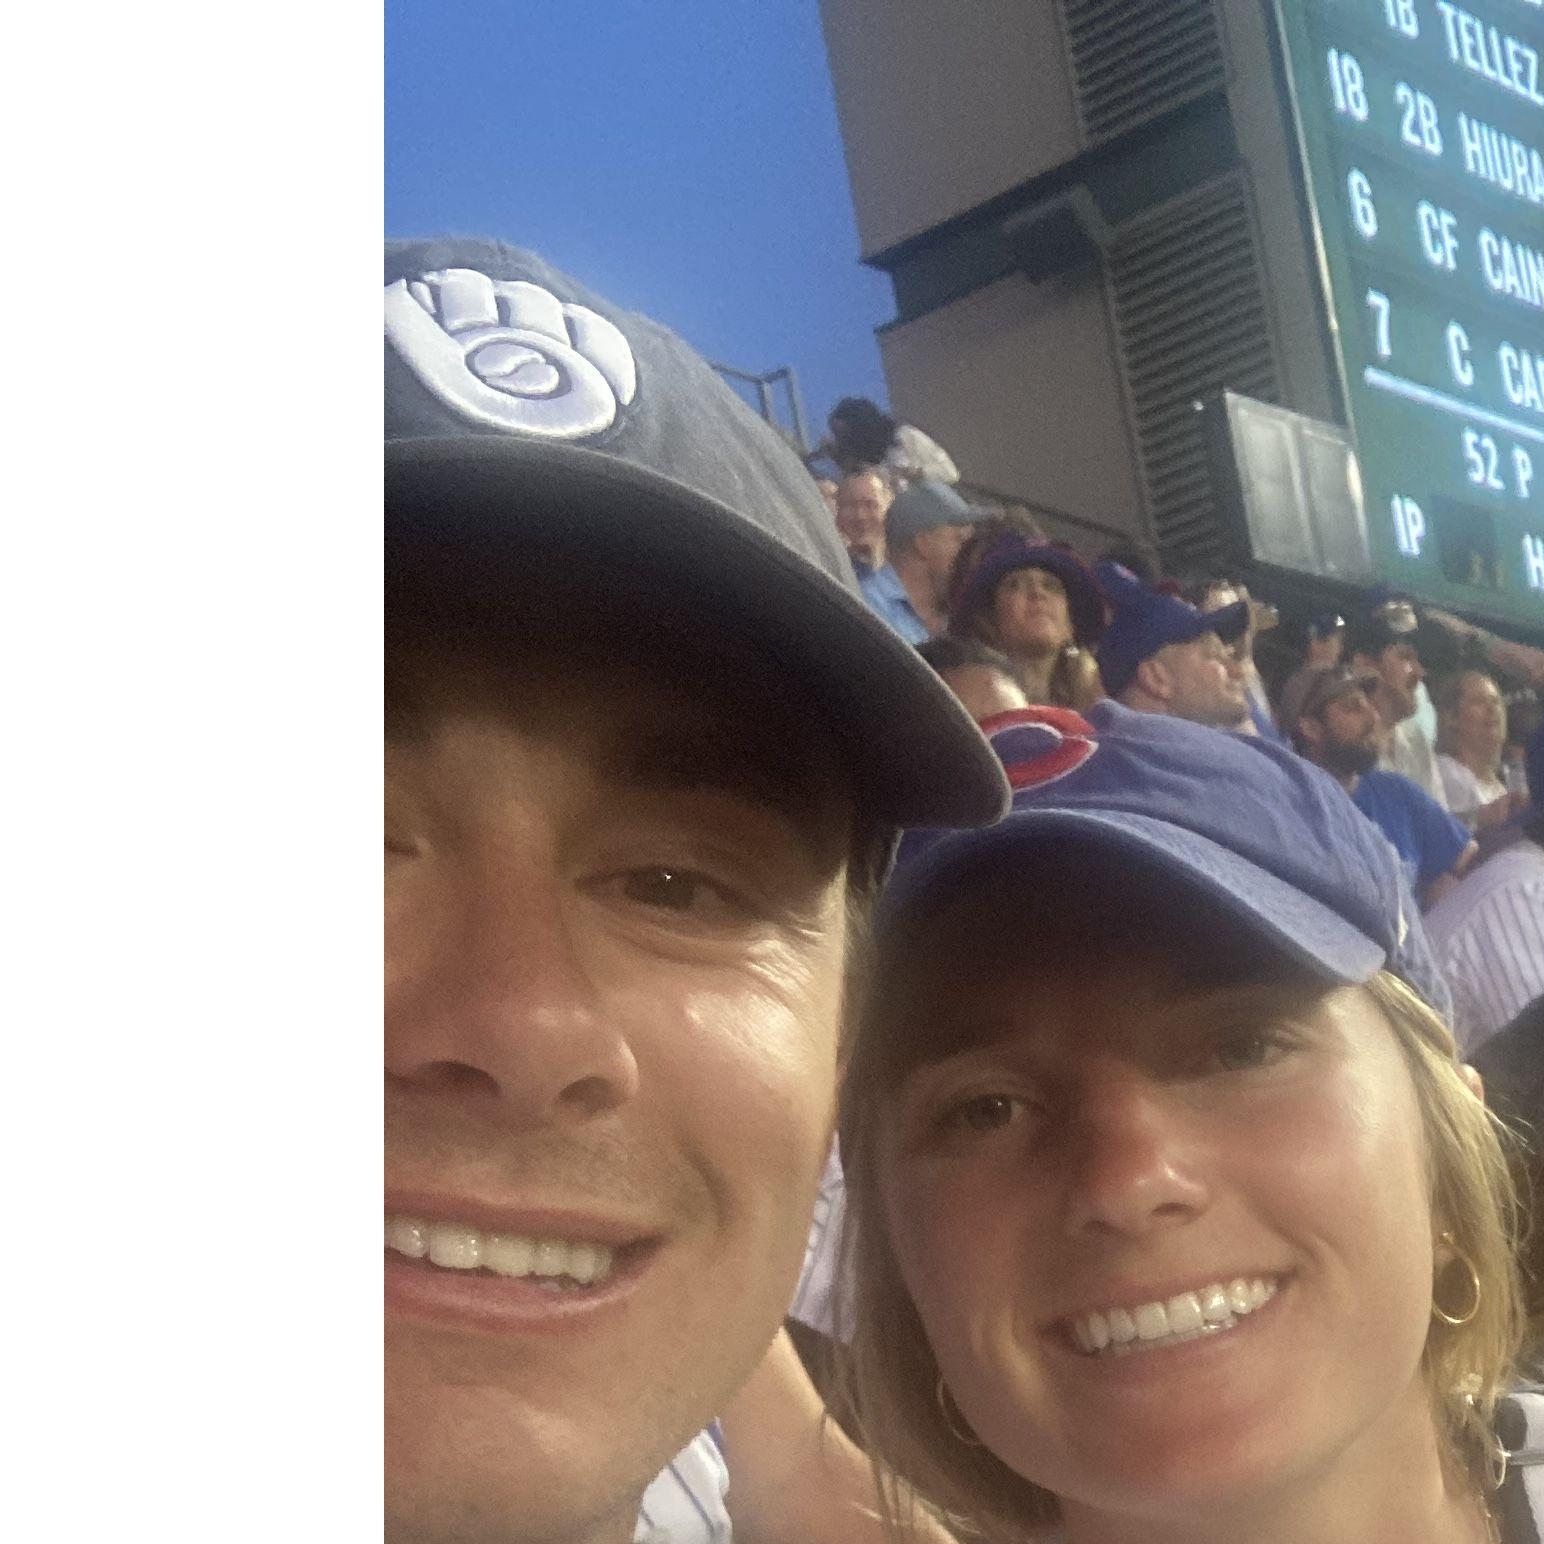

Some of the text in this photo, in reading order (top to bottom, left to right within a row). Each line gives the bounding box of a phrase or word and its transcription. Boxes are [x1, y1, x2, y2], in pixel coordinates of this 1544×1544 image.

[1327, 47, 1369, 123] 18
[1394, 81, 1444, 157] 2B
[1347, 166, 1379, 240] 6
[1416, 198, 1460, 272] CF
[1366, 286, 1392, 361] 7
[1446, 318, 1474, 389] C
[1461, 426, 1506, 491] 52
[1512, 442, 1534, 498] P
[1390, 493, 1426, 560] IP
